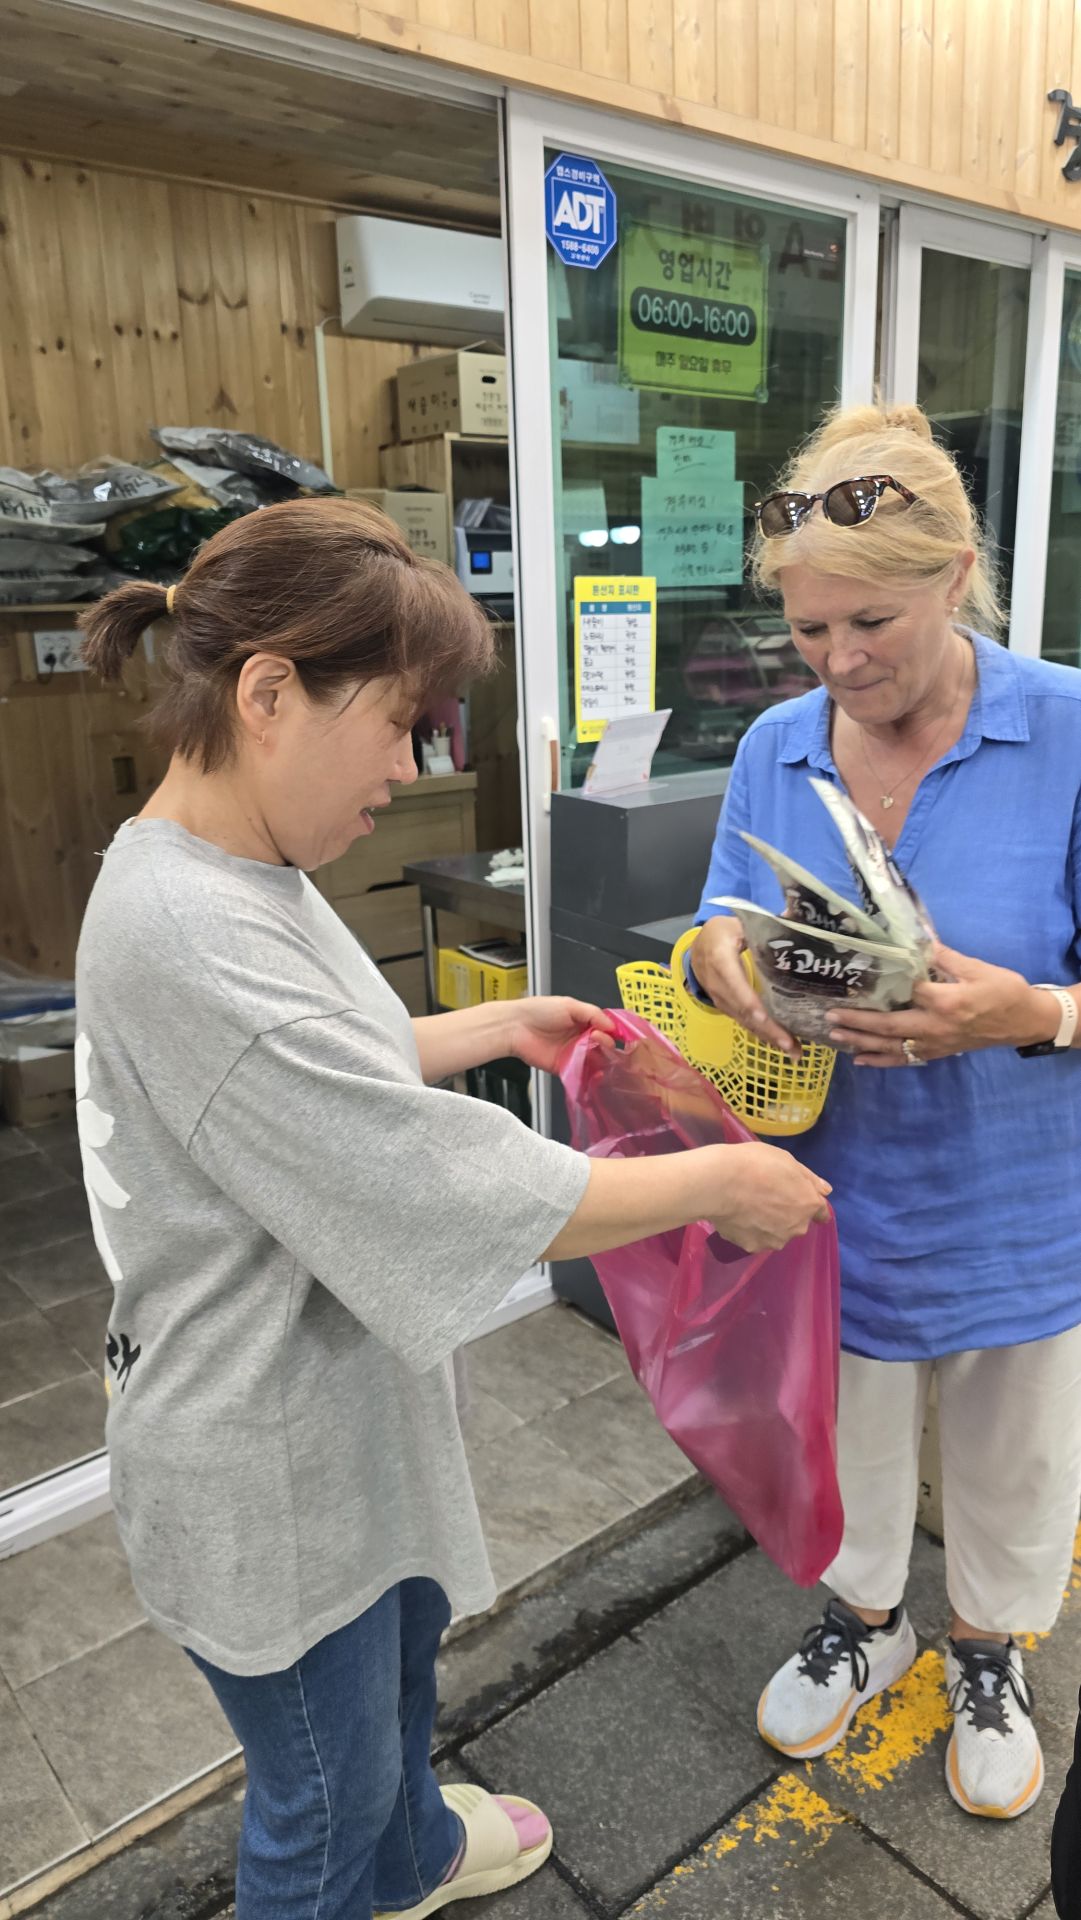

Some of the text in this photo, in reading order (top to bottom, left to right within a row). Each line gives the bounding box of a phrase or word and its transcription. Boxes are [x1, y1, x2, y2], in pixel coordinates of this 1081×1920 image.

[554, 190, 605, 235] ADT
[658, 248, 732, 291] 영업시간
[637, 293, 750, 338] 06:00~16:00
[655, 350, 732, 375] 매주 일요일 휴무
